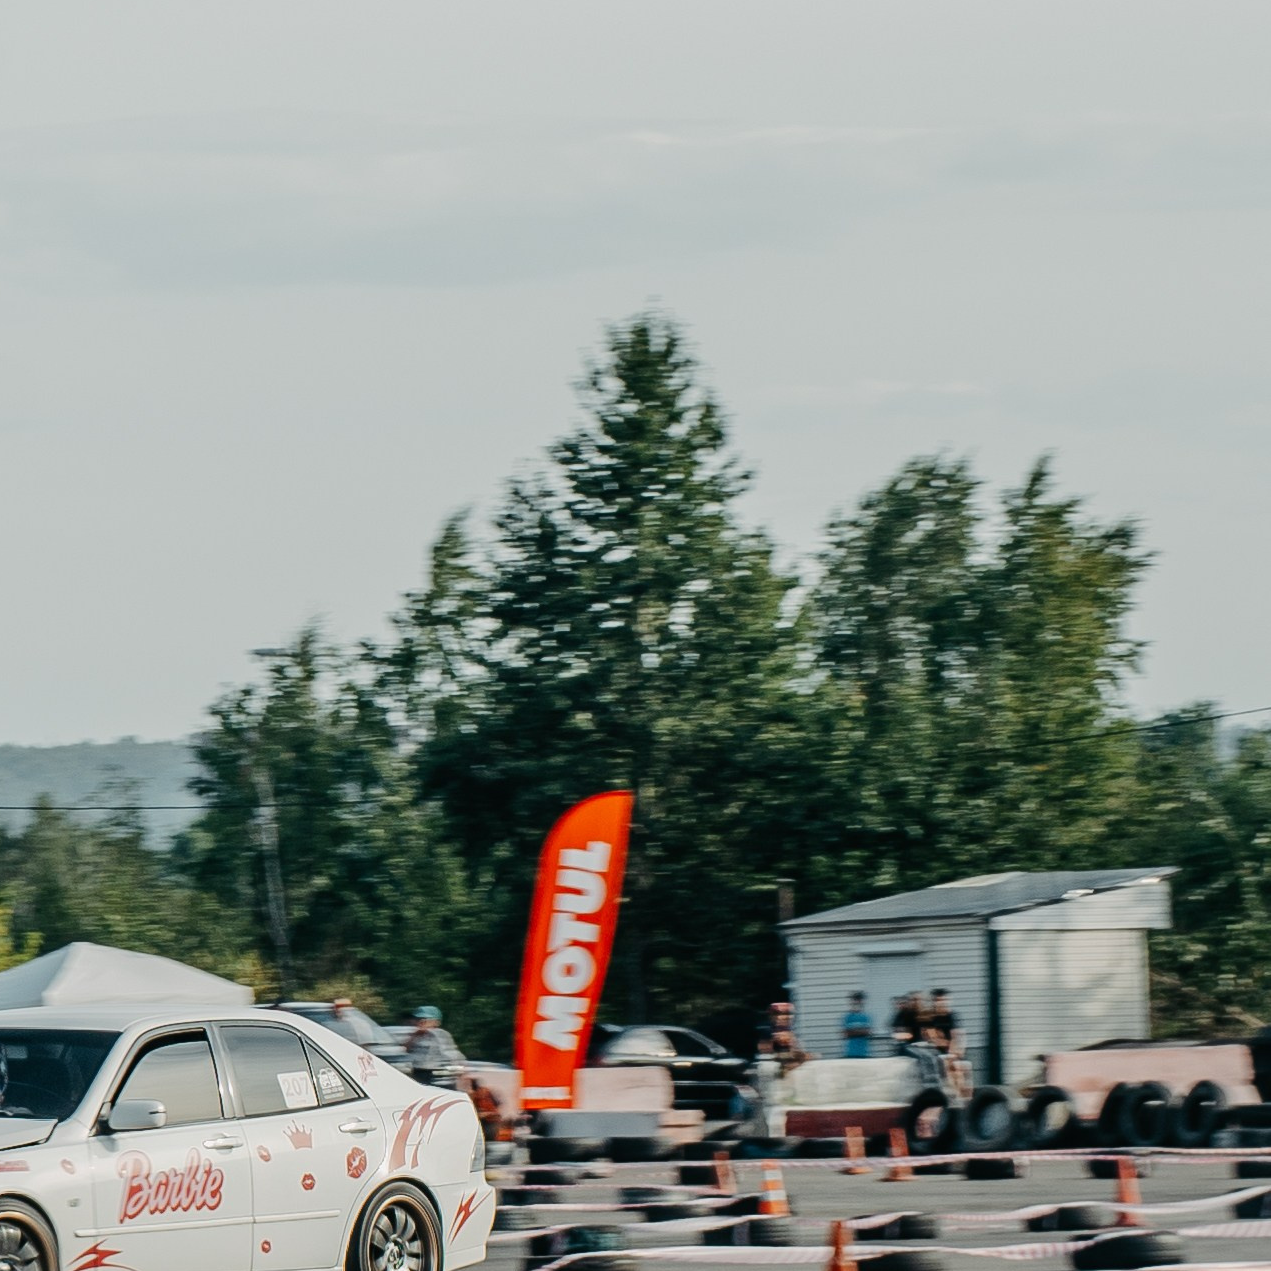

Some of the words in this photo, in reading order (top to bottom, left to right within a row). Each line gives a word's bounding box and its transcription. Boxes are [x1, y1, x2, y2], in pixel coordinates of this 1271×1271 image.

[532, 840, 612, 1051] MOTUL
[282, 1076, 310, 1098] 207
[116, 1147, 225, 1224] Barbie
